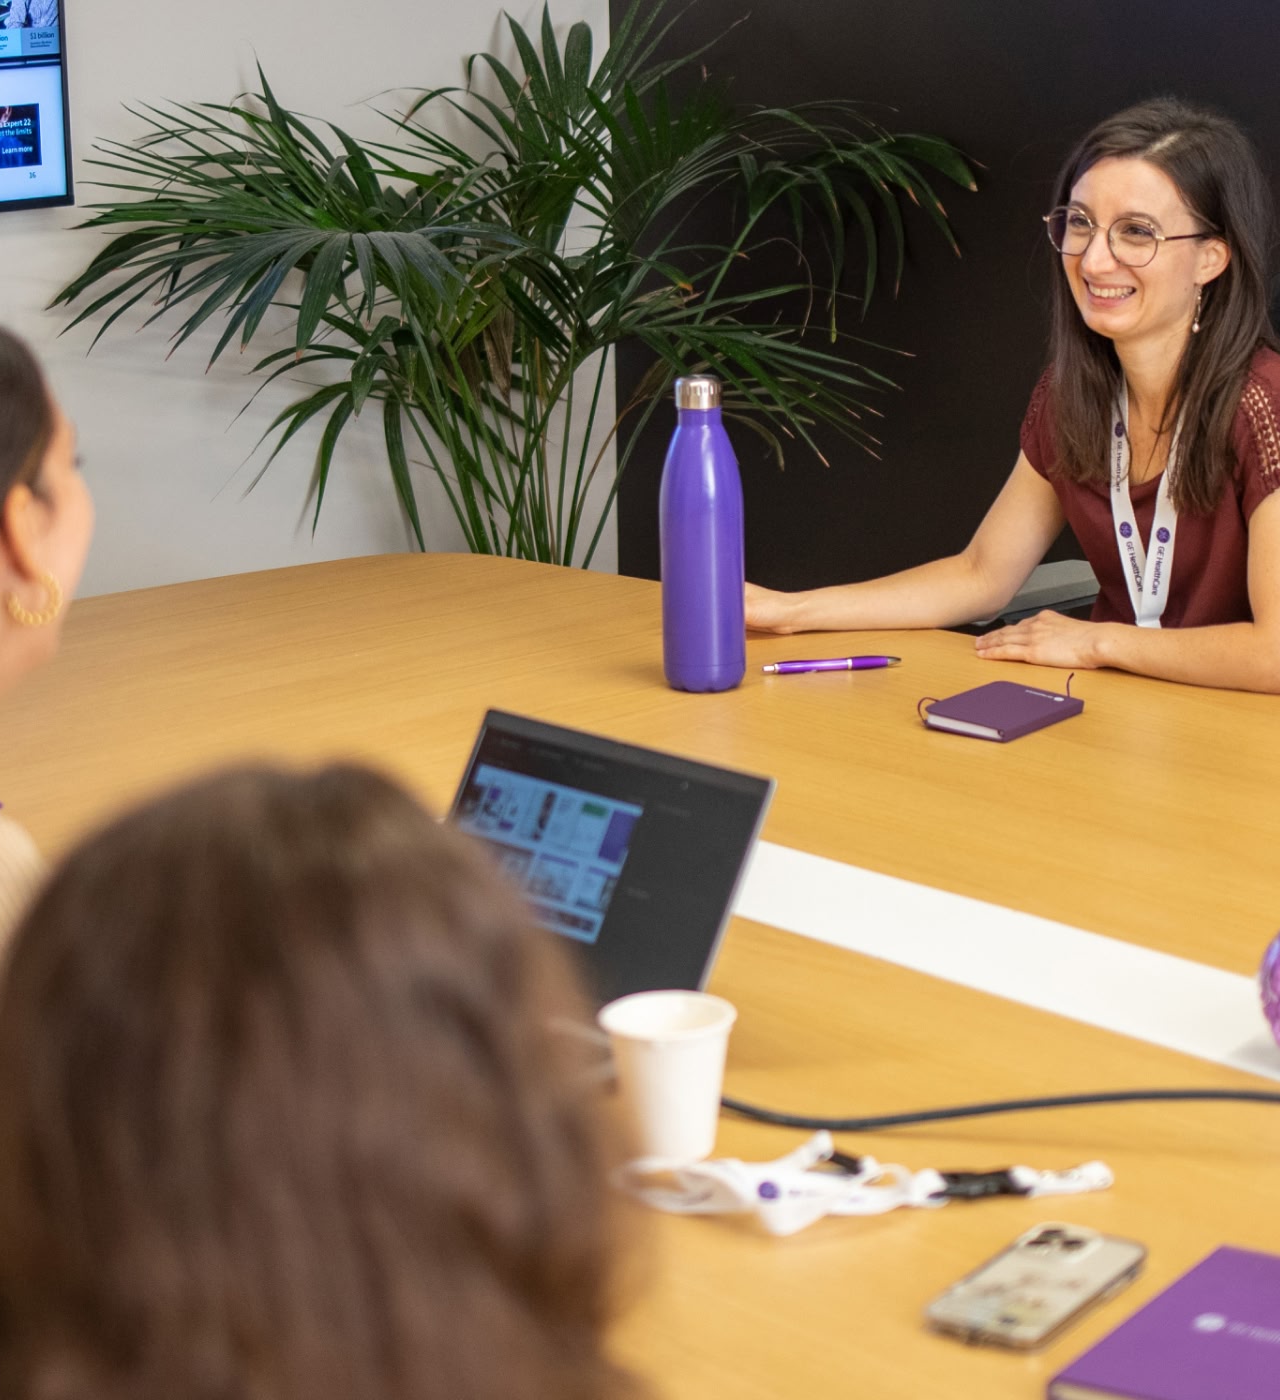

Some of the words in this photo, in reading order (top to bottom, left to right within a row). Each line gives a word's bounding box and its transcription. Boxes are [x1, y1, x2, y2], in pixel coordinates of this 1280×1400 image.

[23, 118, 32, 126] 22
[2, 146, 18, 154] Learn
[18, 145, 33, 153] more
[1126, 541, 1135, 553] GE
[1157, 545, 1166, 557] GE
[1129, 552, 1143, 593] HealthCare
[1151, 556, 1163, 596] HealthCare
